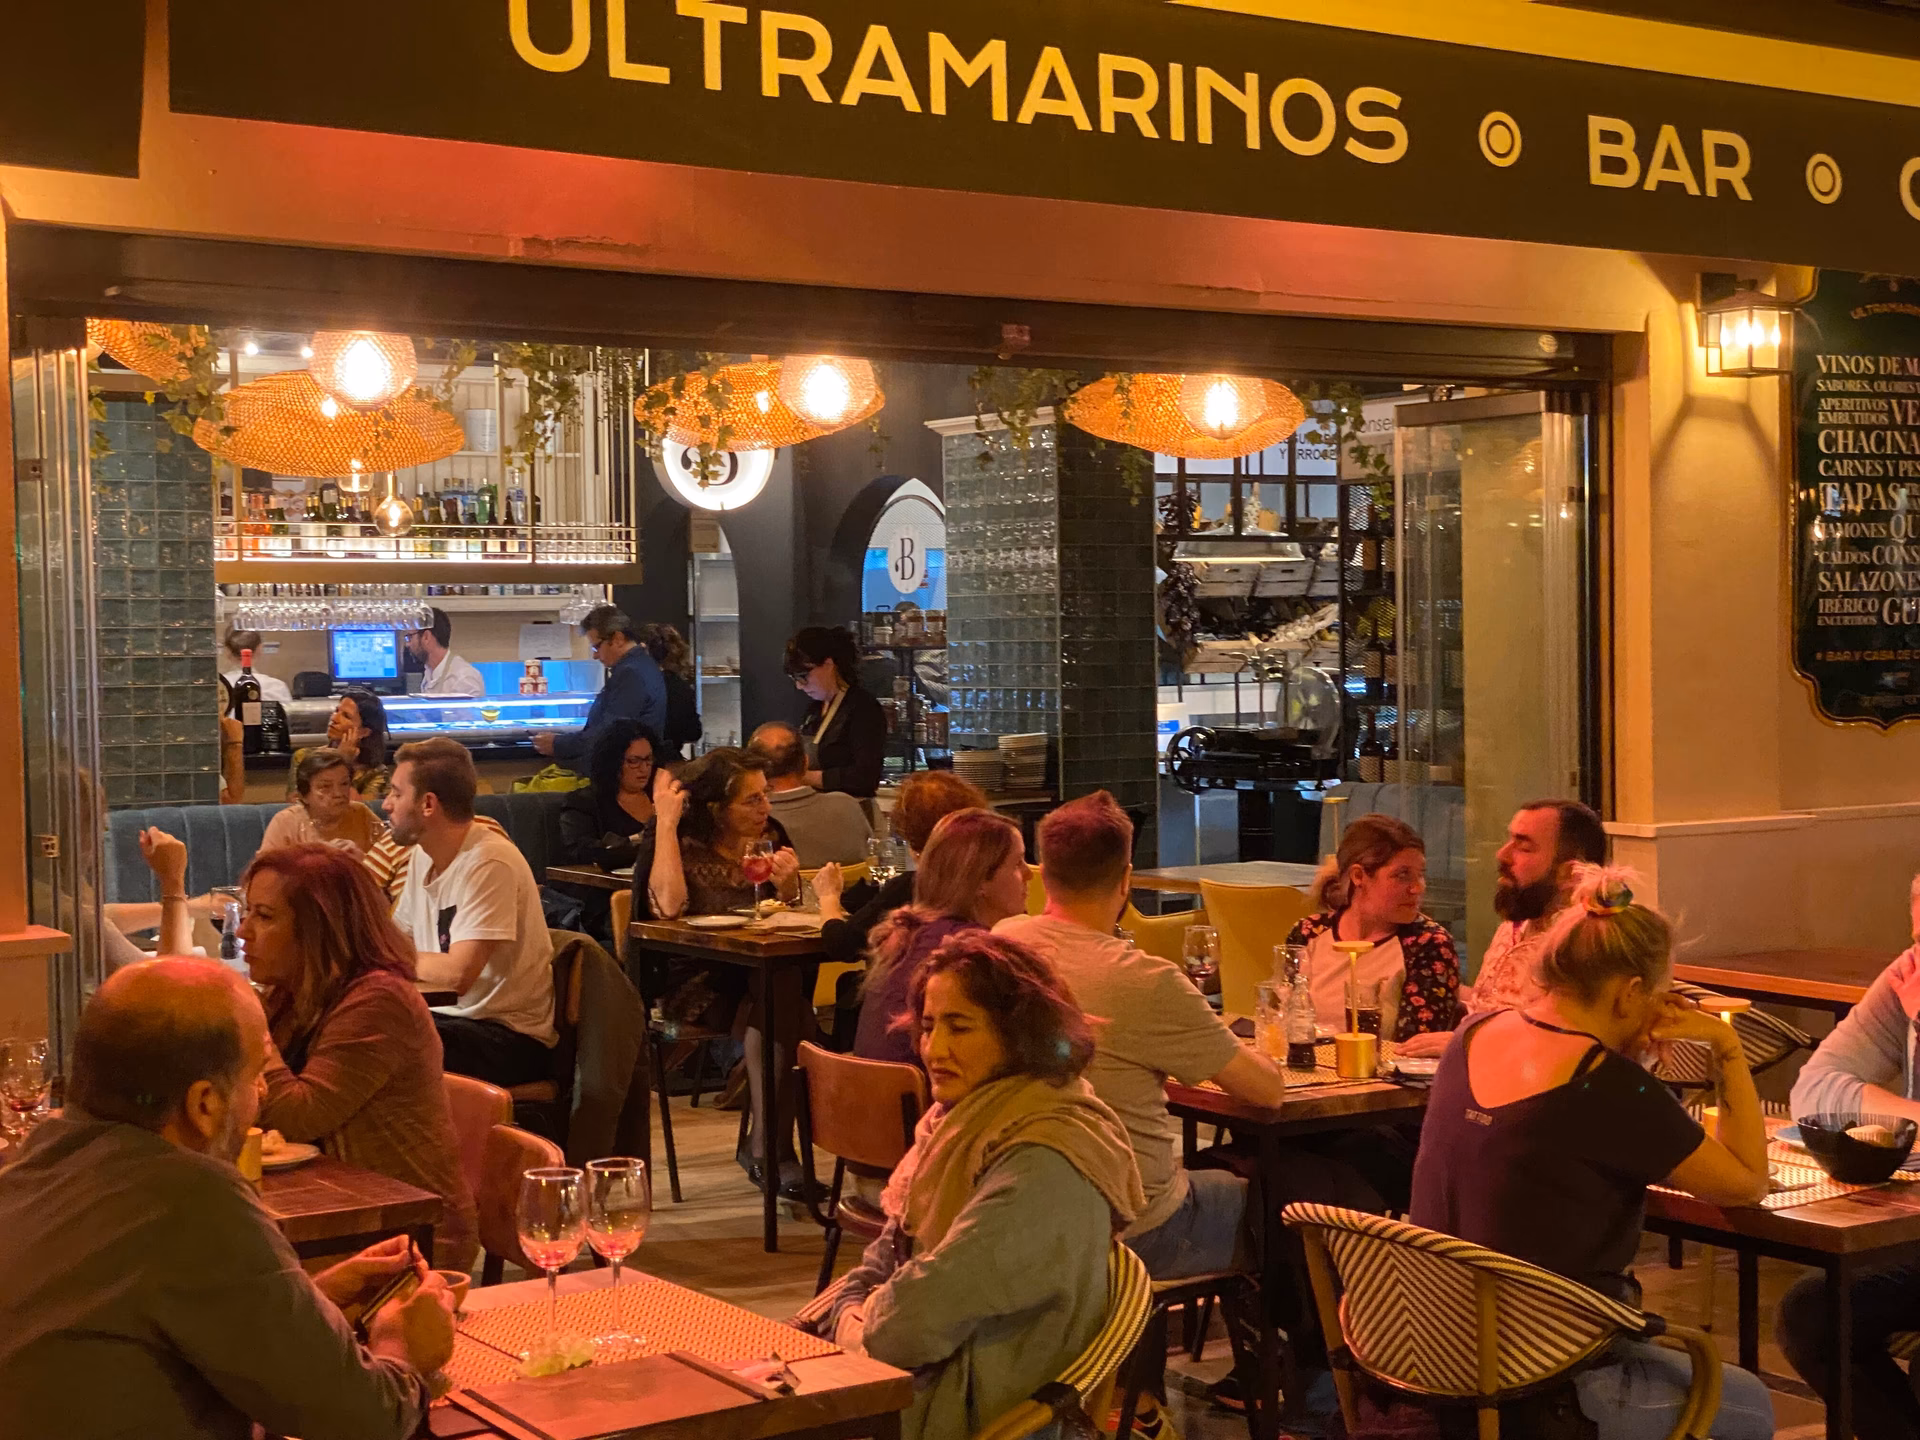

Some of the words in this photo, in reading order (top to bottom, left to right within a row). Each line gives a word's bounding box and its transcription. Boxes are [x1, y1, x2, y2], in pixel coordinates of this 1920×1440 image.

[508, 0, 1409, 164] ULTRAMARINOS
[1588, 115, 1753, 201] BAR
[1816, 355, 1876, 375] VINOS
[1879, 356, 1902, 375] DE
[1816, 380, 1873, 393] SABORES,
[1818, 398, 1889, 411] APERITIVOS
[1818, 411, 1889, 425] EMBUTIDOS
[1818, 459, 1884, 477] CARNES
[1885, 460, 1897, 477] Y
[1819, 482, 1901, 511] TAPAS
[894, 537, 915, 581] B
[1819, 551, 1871, 565] CALDOS
[1818, 571, 1920, 592] SALAZONE
[1818, 594, 1879, 614] IBÉRICO
